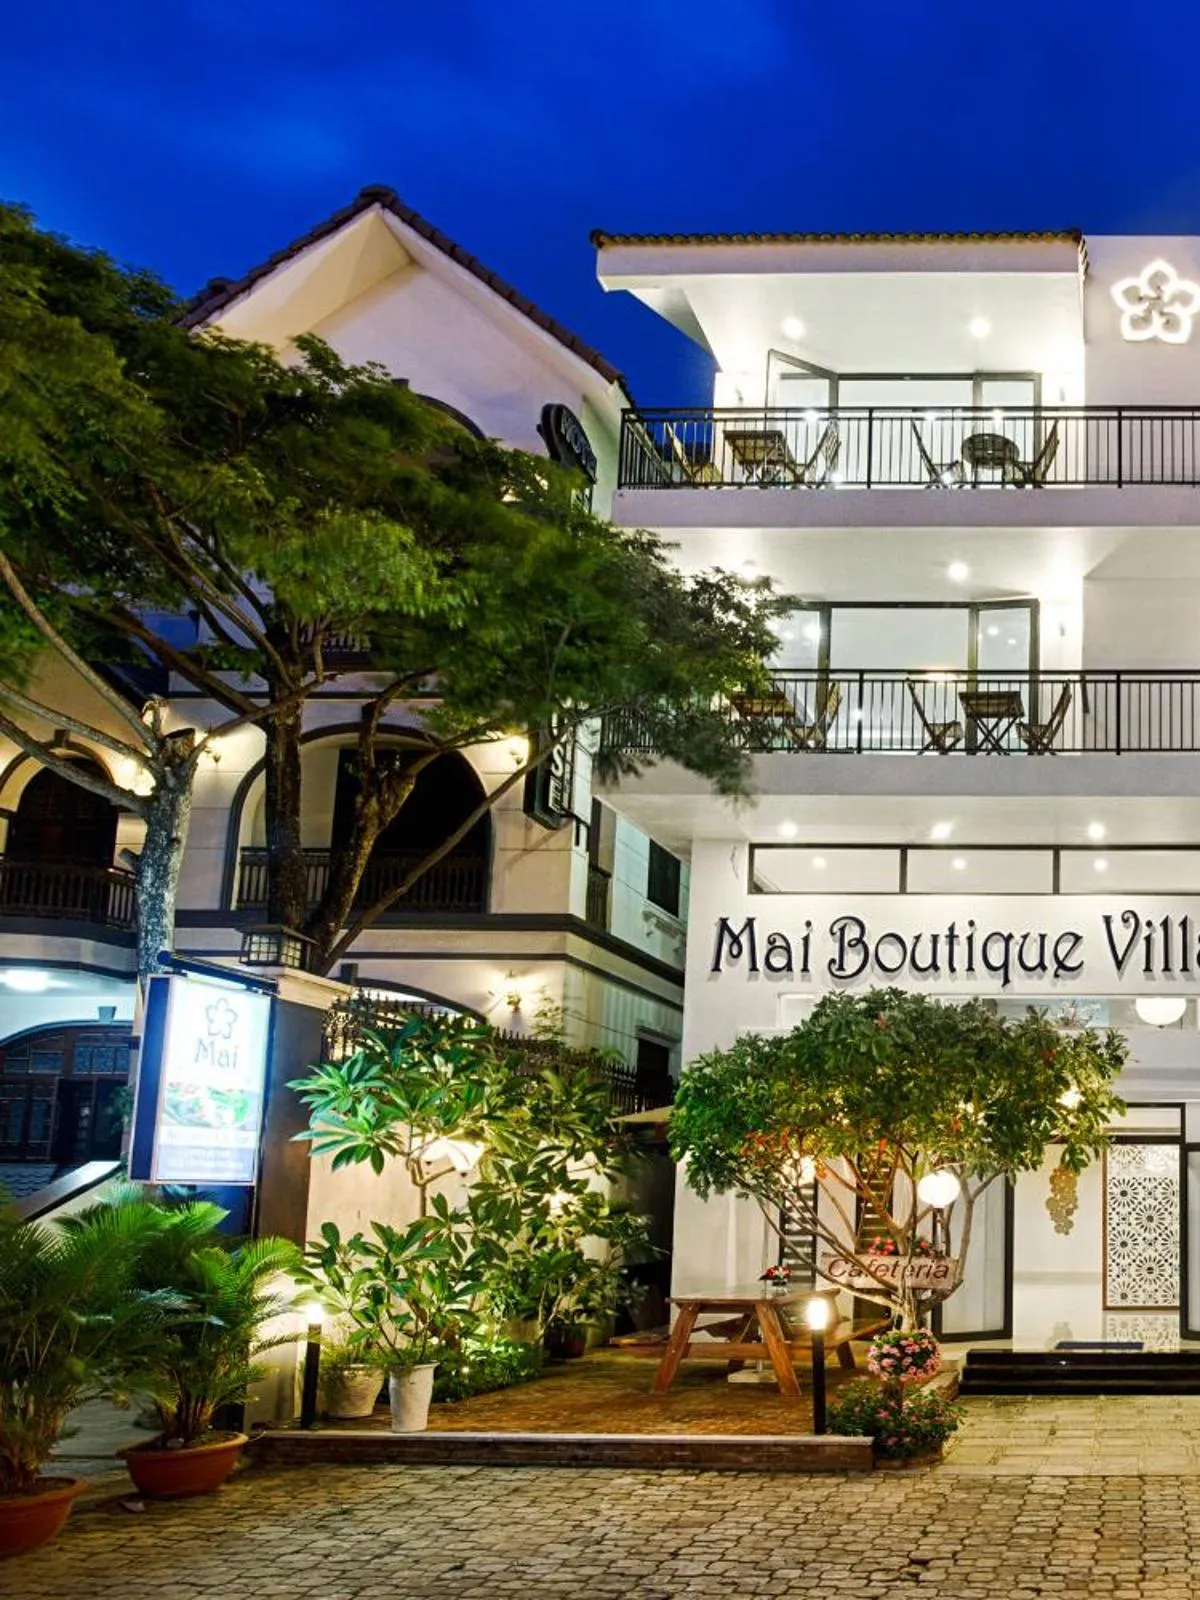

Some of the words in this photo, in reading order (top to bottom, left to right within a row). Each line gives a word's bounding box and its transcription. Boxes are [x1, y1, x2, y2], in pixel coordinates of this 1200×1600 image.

[709, 917, 812, 974] Mai
[826, 915, 1085, 988] Boutique
[194, 1038, 239, 1068] Mai
